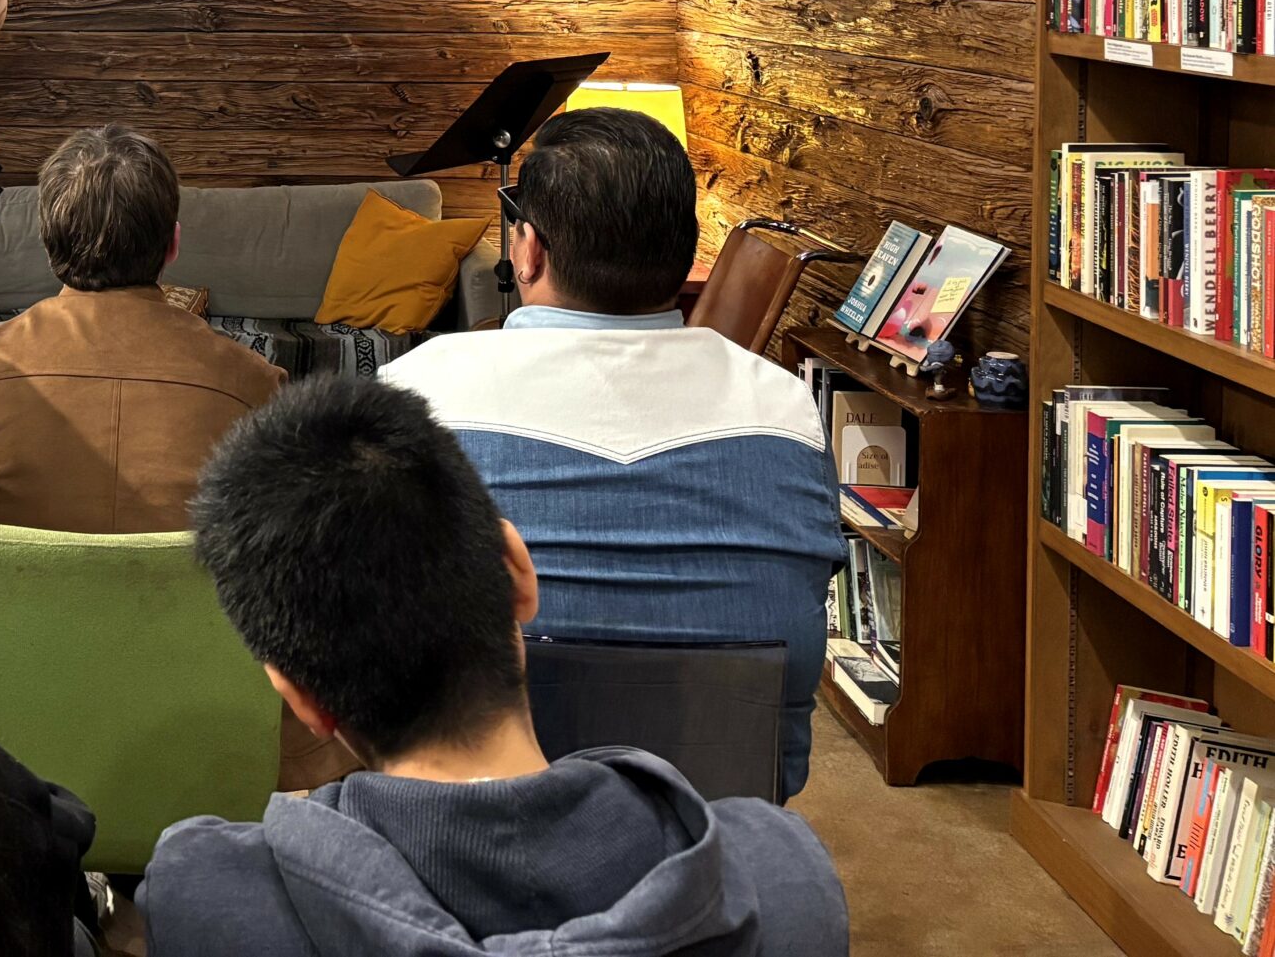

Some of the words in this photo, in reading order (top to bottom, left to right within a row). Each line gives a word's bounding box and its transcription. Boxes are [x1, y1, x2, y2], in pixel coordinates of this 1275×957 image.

[1205, 183, 1216, 239] BERRY
[883, 241, 900, 253] HIGH
[1251, 204, 1261, 292] GODSHOT
[847, 296, 867, 312] JOSHUA
[1205, 249, 1216, 332] WENDELL
[840, 305, 863, 323] WHEELER
[1160, 492, 1166, 500] of
[1255, 526, 1263, 579] GLORY
[1168, 734, 1180, 765] EDITH
[1206, 746, 1269, 770] EDITH
[1160, 768, 1173, 809] HOLLER
[1155, 817, 1166, 850] EDWARD
